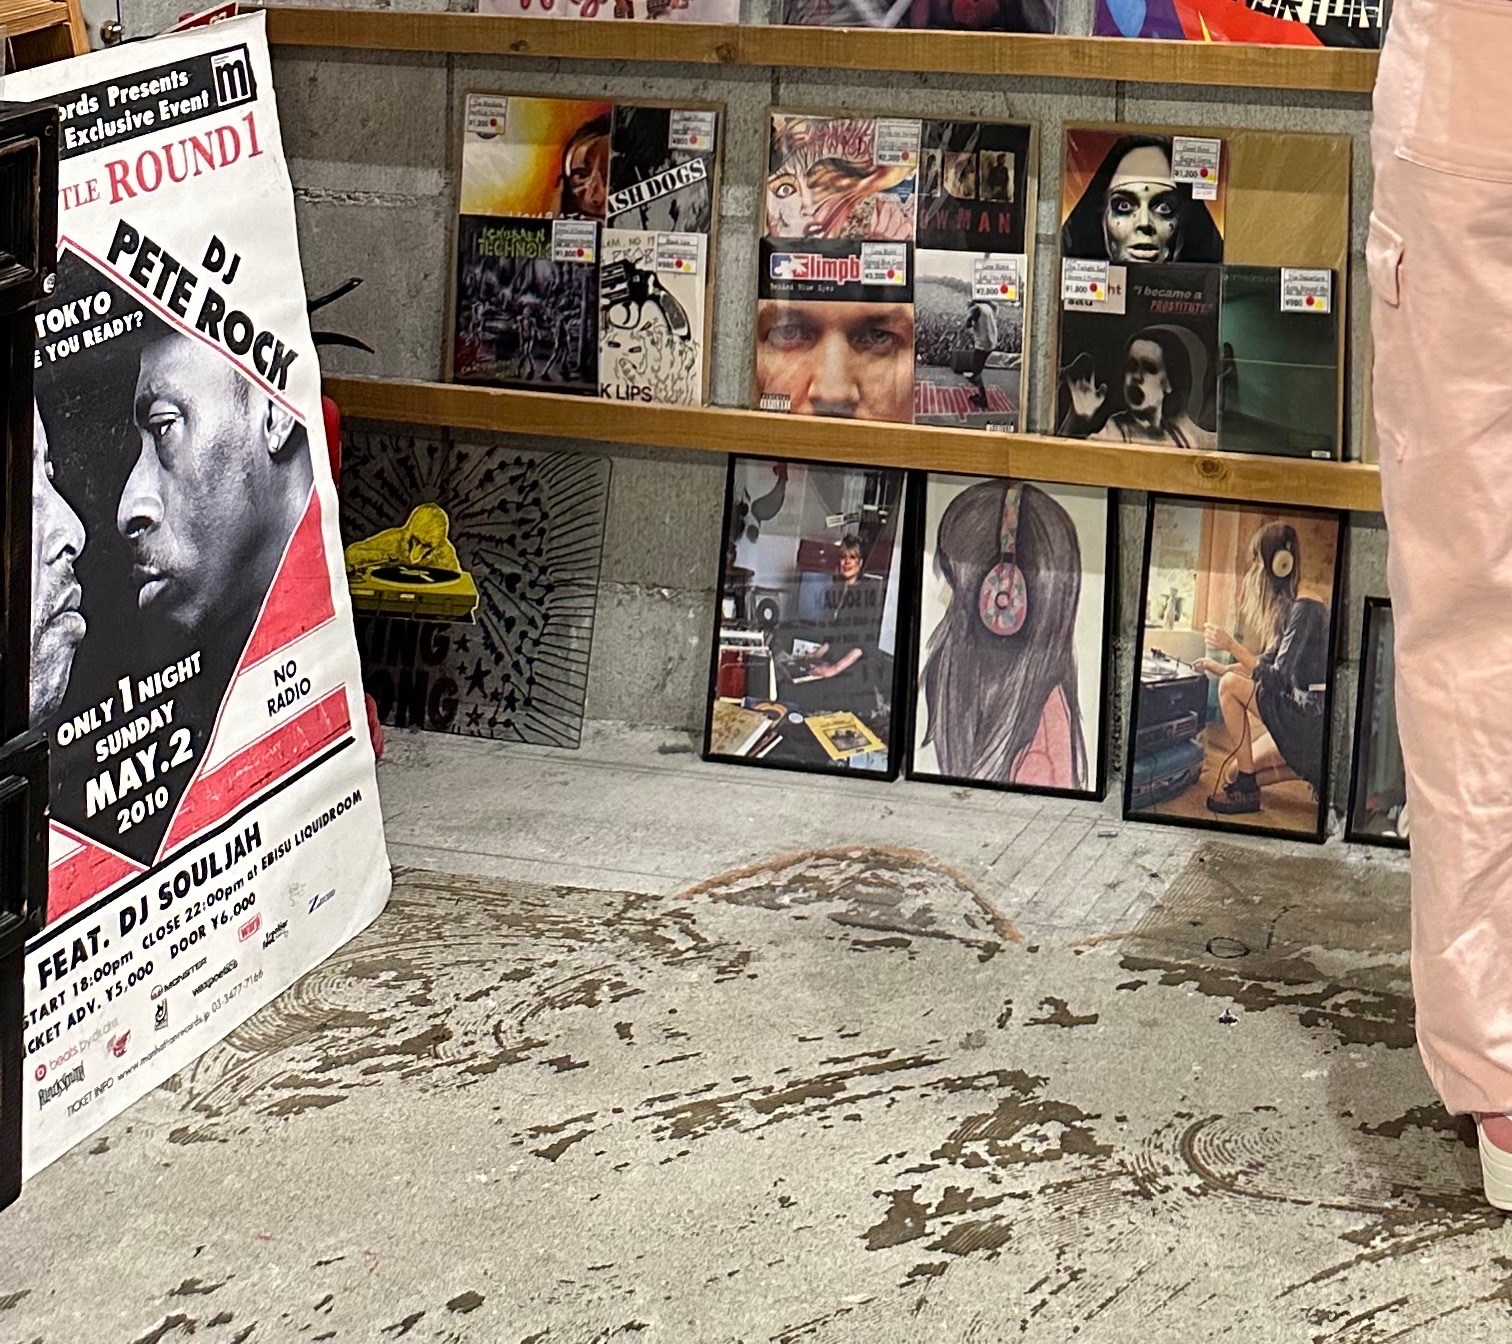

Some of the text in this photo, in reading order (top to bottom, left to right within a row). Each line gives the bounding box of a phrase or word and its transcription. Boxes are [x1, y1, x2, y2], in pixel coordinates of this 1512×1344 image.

[107, 70, 190, 107] Presents
[64, 89, 210, 150] Exclusive Event
[647, 159, 704, 198] DOGS
[201, 234, 242, 285] DJ
[35, 290, 112, 339] TOKYO
[106, 218, 300, 391] PETE ROCK
[45, 310, 145, 363] YOU READY?
[616, 385, 653, 402] LIPS
[57, 651, 202, 748] ONLY 1 NIGHT
[266, 678, 312, 718] RADIO
[272, 660, 298, 687] NO
[95, 699, 175, 763] SUNDAY
[84, 727, 195, 818] MAY.2
[116, 788, 170, 835] 2010
[37, 821, 263, 991] FEAT. DJ SOULJAH
[71, 949, 134, 998] 18:00pm
[141, 914, 182, 951] CLOSE
[185, 877, 245, 924] 22:00pm
[245, 864, 260, 882] at
[260, 837, 292, 870] EBISU
[294, 788, 364, 852] LIQUIDROOM
[67, 1000, 103, 1032] ADV.
[169, 923, 207, 961] DOOR
